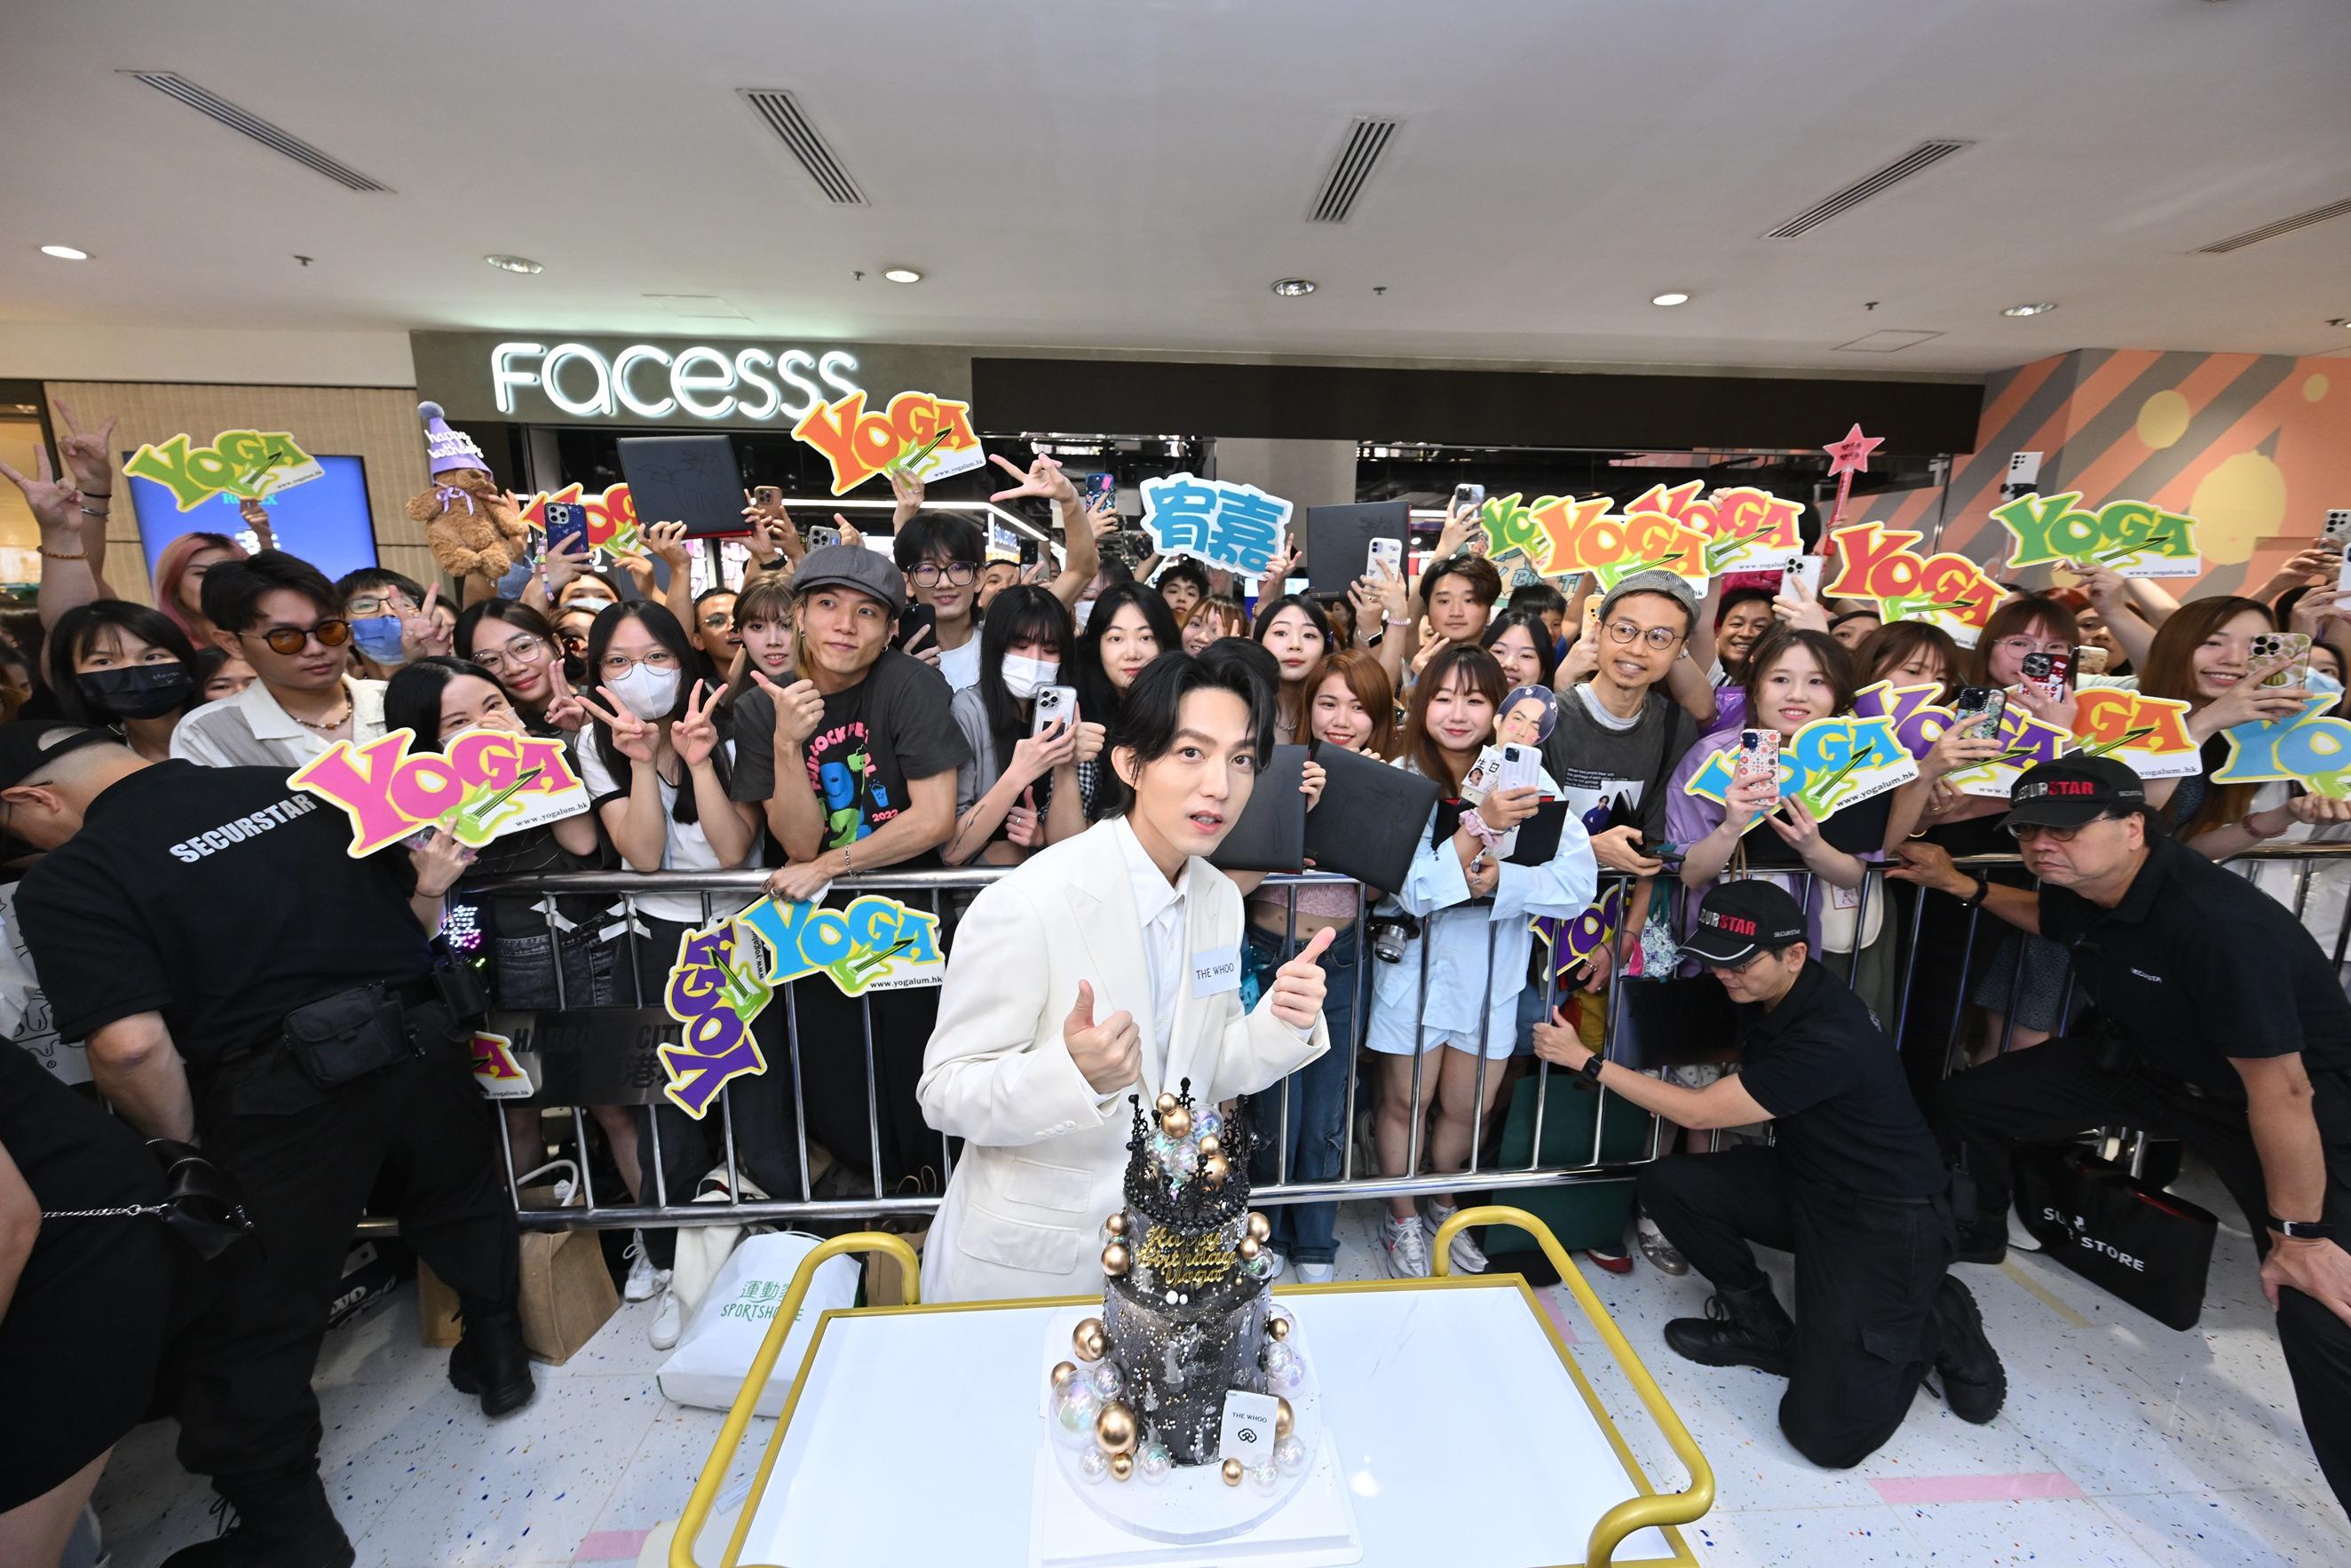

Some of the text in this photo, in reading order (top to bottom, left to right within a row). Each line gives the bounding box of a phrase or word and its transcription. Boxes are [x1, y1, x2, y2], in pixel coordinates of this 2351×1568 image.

[127, 432, 311, 509] YOGA
[796, 393, 976, 492] YOGA
[1149, 480, 1284, 573] 宥嘉
[1532, 503, 1709, 575] YOGA
[1993, 495, 2197, 564] YOGA
[1829, 527, 2001, 627] YOGA
[296, 733, 580, 851] YOGA
[516, 801, 590, 828] www.yogalum.hk
[1836, 771, 1916, 808] www.yogalum.hk
[169, 794, 318, 863] SECURSTAR
[742, 900, 939, 981] YOGA
[1196, 962, 1234, 980] THE WHOO
[870, 976, 943, 988] www.yogalum.hk
[663, 921, 763, 1114] YOGA
[2080, 1237, 2145, 1272] STORE
[1247, 1414, 1268, 1422] WHOO
